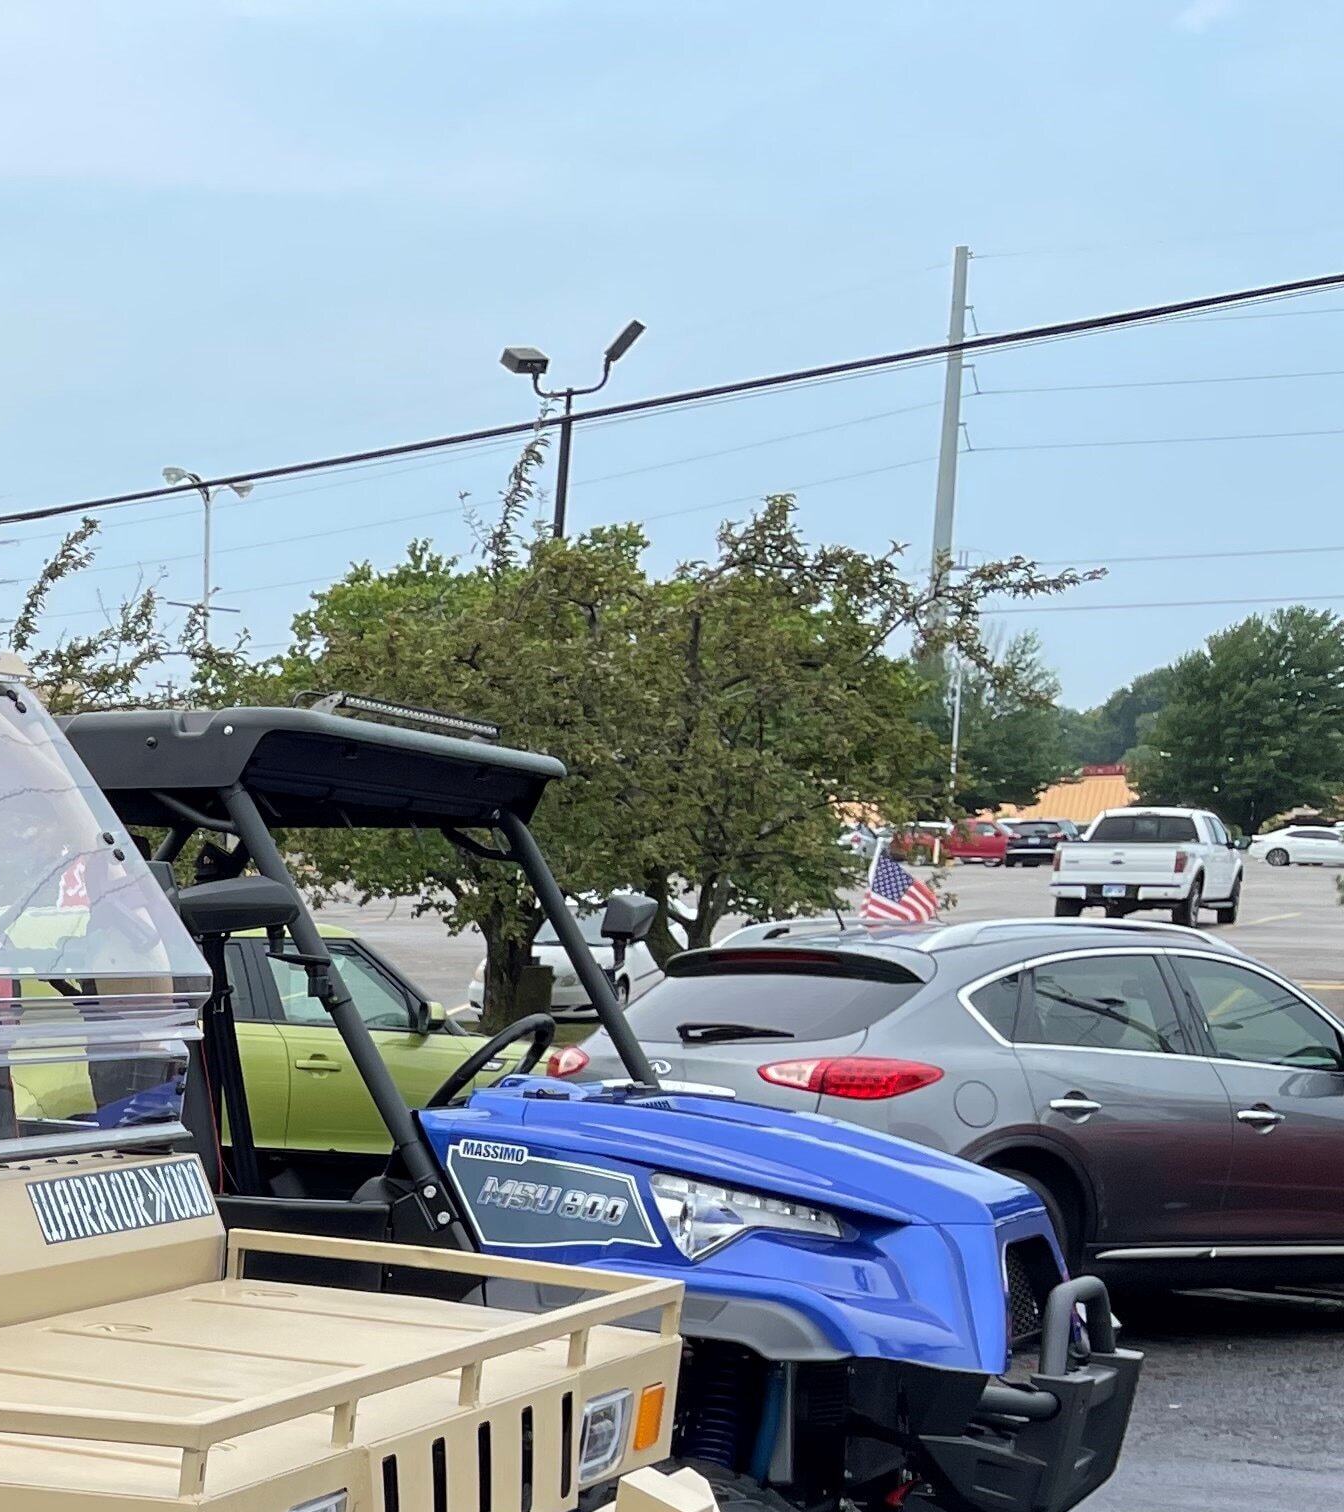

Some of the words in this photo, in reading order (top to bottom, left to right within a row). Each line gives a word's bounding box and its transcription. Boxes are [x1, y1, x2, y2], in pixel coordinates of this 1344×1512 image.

[462, 1142, 524, 1162] MASSIMO
[28, 1170, 154, 1242] WARRIOR
[558, 1190, 628, 1226] 800
